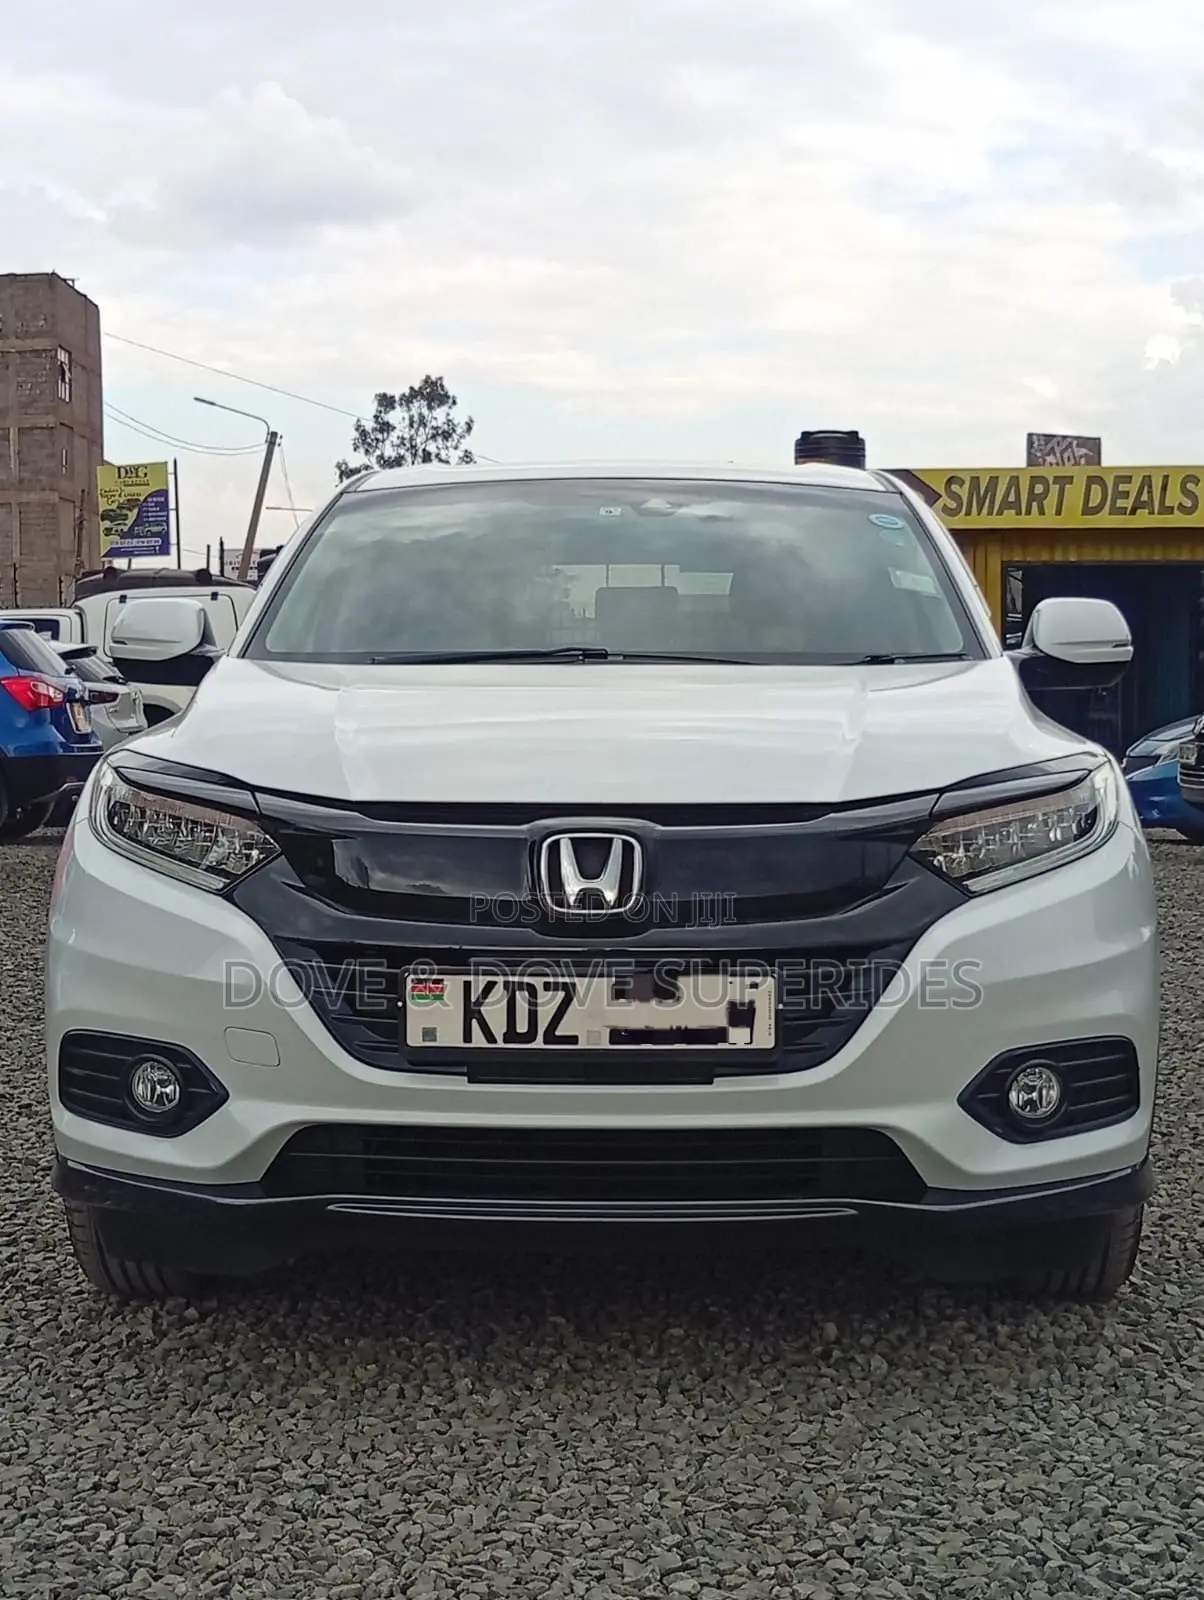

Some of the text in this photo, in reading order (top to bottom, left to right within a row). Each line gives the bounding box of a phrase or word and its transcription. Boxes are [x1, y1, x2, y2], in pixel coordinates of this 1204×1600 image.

[941, 474, 1201, 518] SMART DEALS
[462, 979, 580, 1046] KDZ
